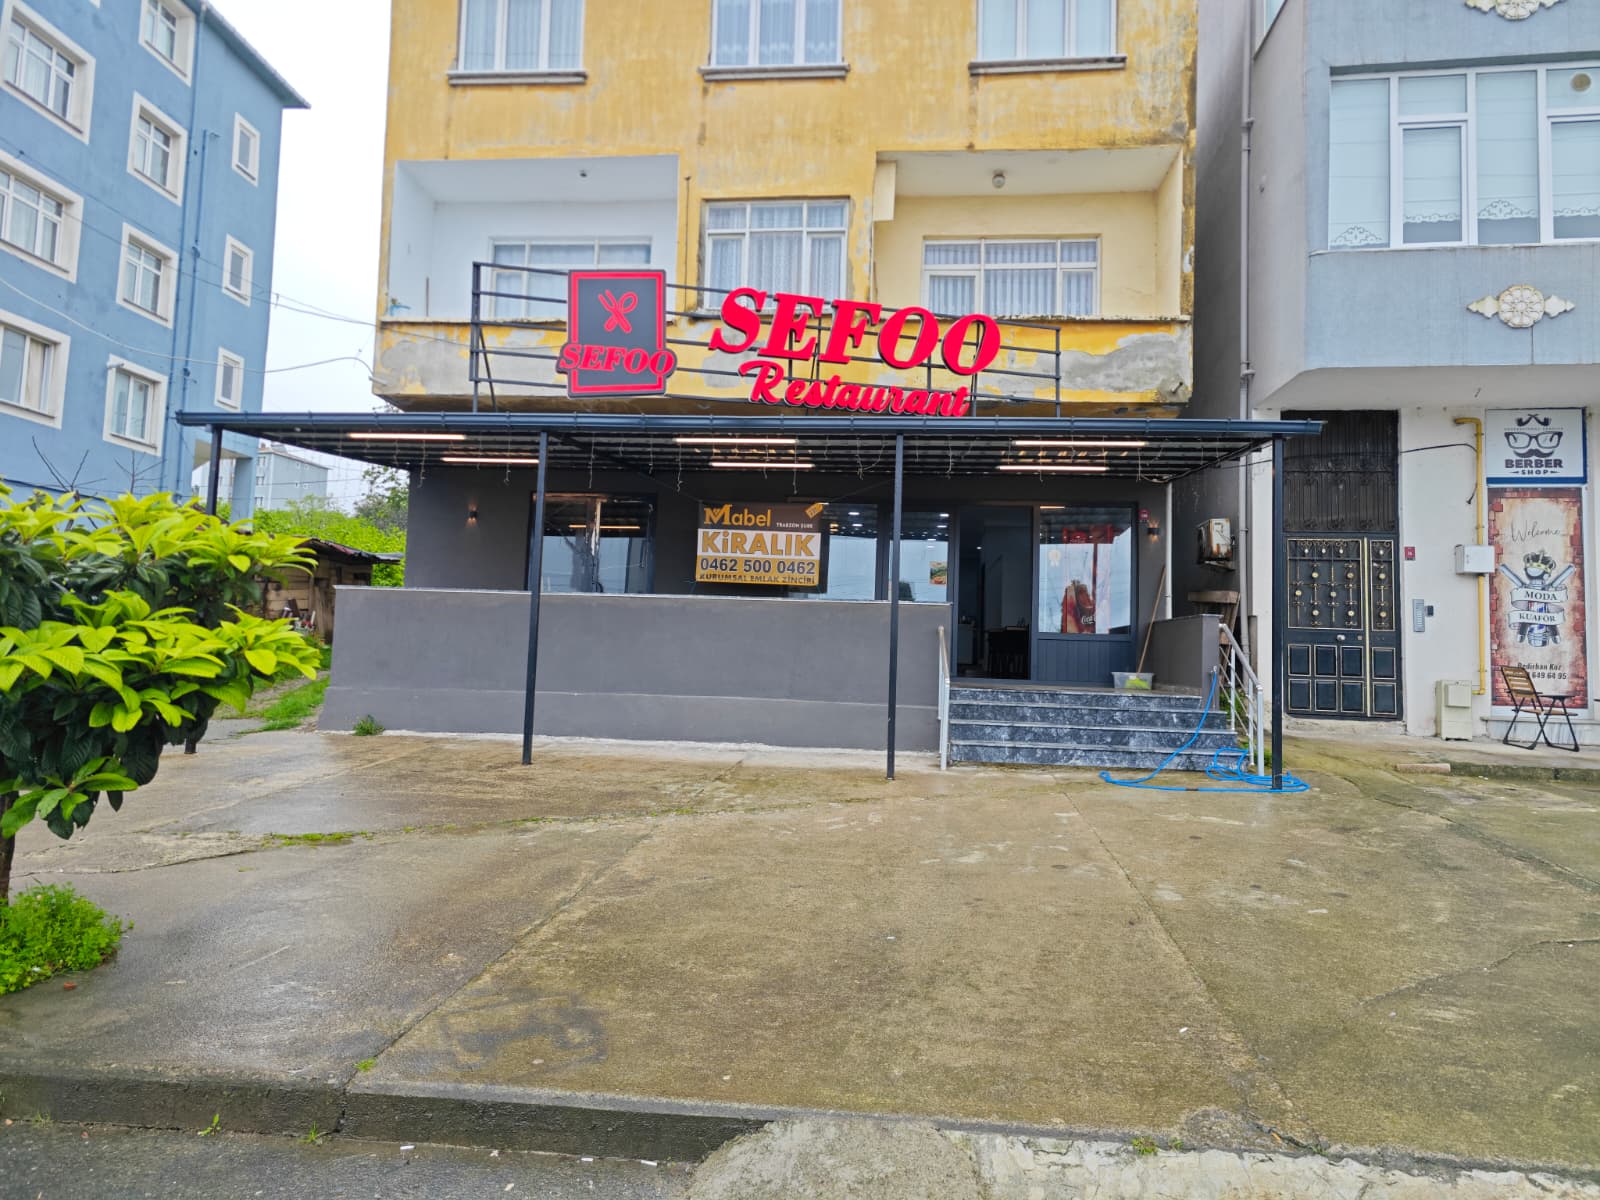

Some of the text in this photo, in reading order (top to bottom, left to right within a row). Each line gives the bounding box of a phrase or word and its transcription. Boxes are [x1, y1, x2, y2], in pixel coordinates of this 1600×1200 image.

[709, 287, 1001, 376] SEFOO
[559, 344, 675, 375] SEFOO
[739, 360, 971, 418] Restaurant
[1505, 459, 1563, 469] BERBER
[703, 504, 771, 527] Mabel
[1510, 519, 1561, 542] Welcome
[700, 558, 816, 574] 0462 500 0462
[700, 573, 747, 582] KURUMSAL
[750, 575, 780, 583] EMLAK
[1523, 591, 1558, 600] MODA
[1557, 672, 1567, 680] 95
